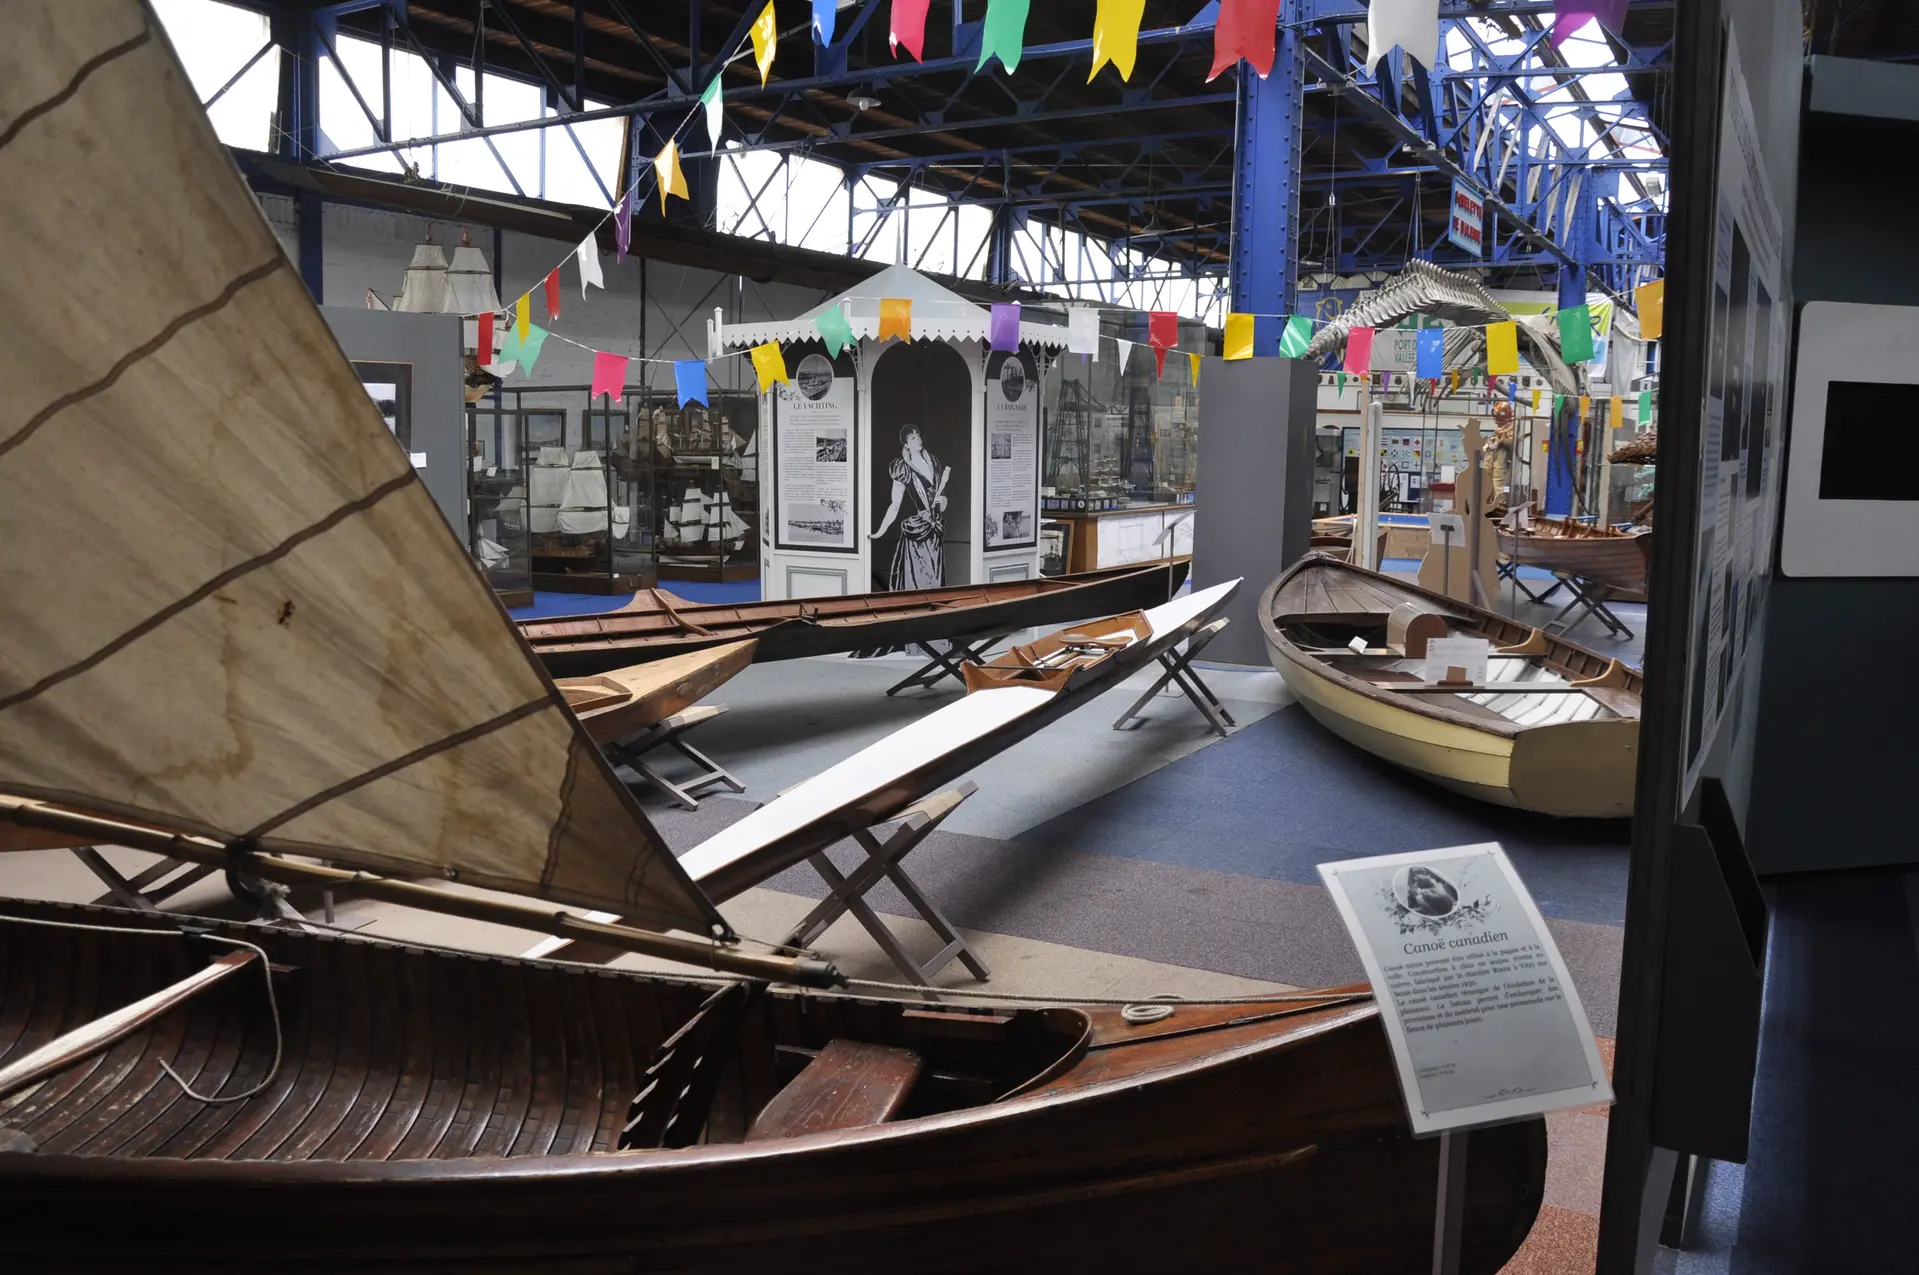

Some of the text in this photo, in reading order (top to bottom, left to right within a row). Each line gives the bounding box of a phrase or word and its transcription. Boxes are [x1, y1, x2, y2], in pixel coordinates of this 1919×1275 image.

[1394, 339, 1411, 350] PORT
[1403, 931, 1509, 955] Canoë canadien
[1383, 964, 1403, 973] Canoë
[1408, 968, 1448, 977] Construction
